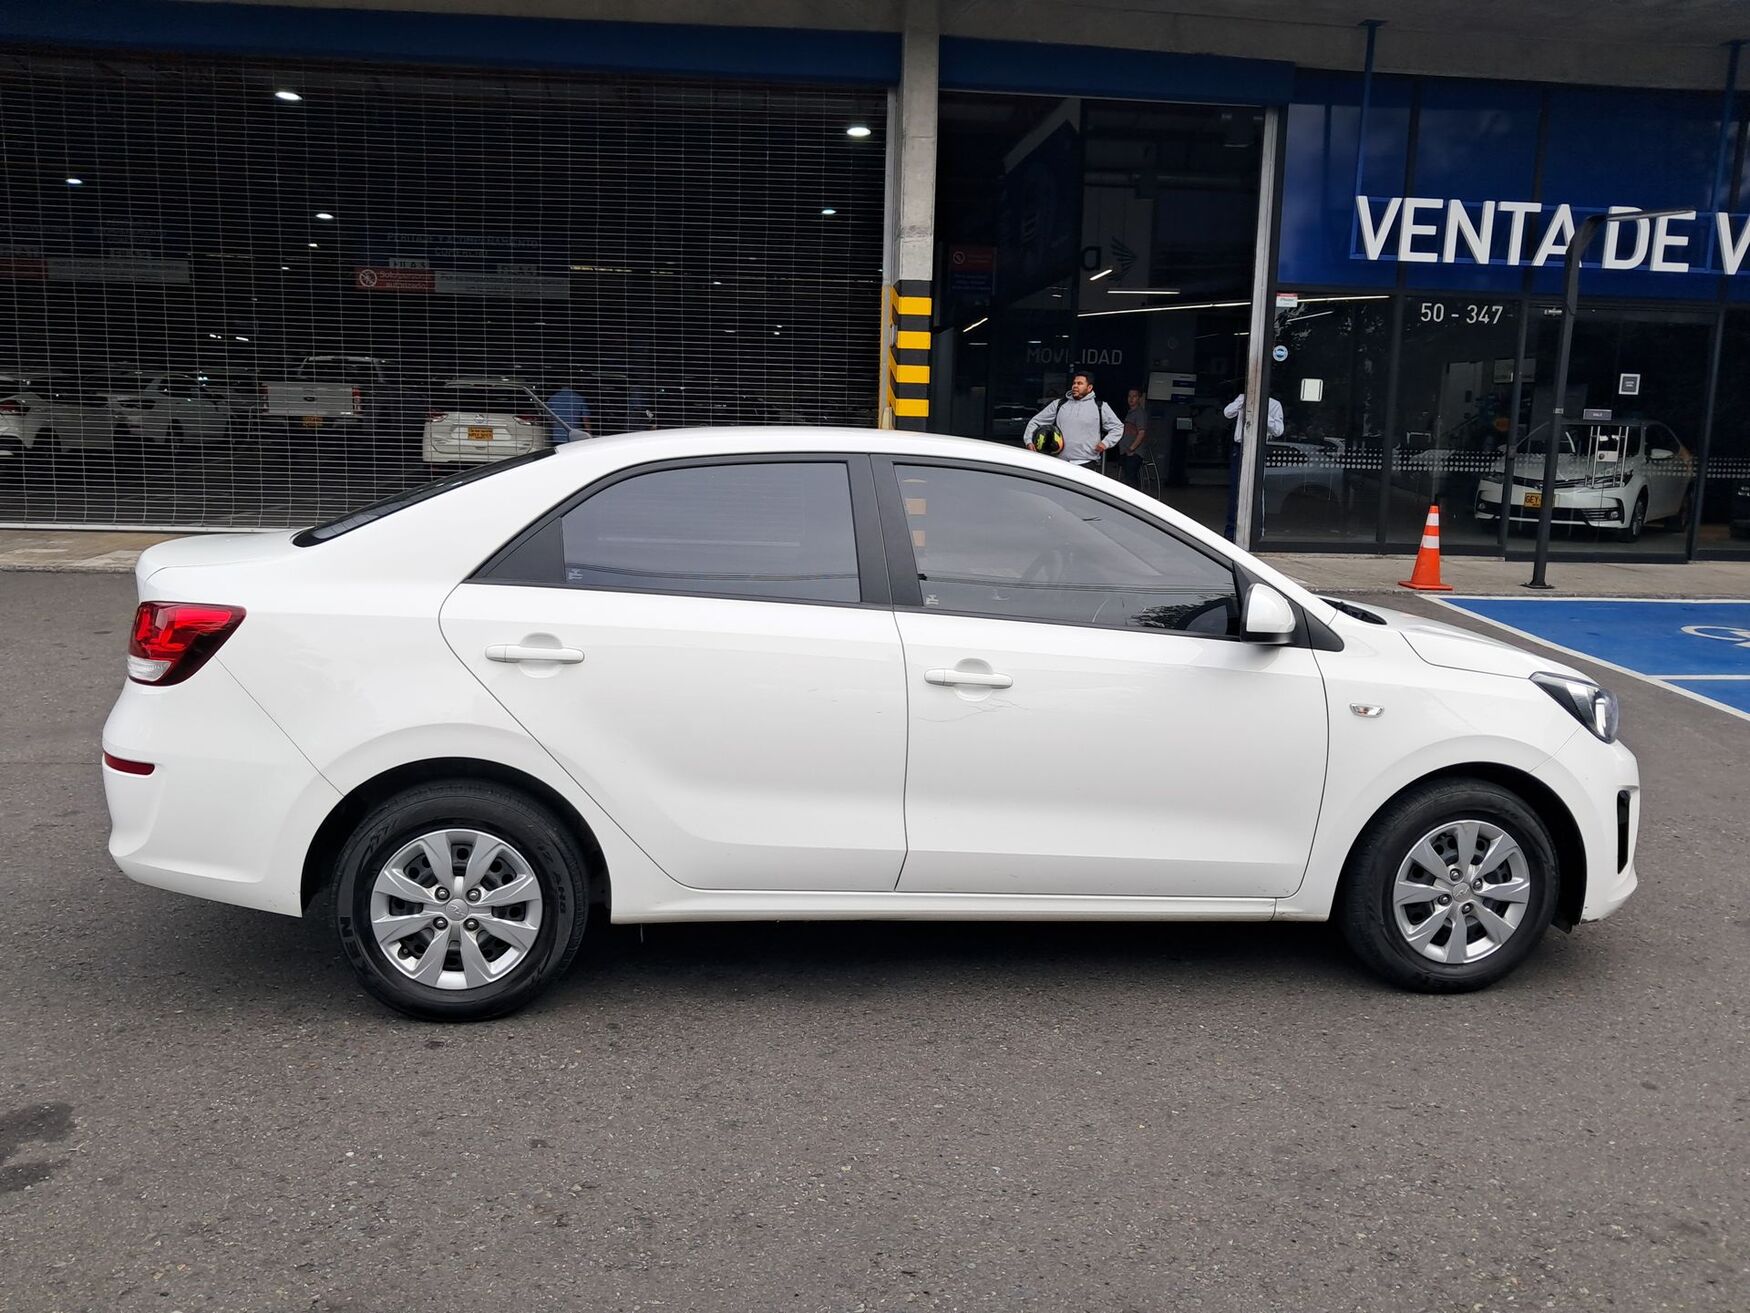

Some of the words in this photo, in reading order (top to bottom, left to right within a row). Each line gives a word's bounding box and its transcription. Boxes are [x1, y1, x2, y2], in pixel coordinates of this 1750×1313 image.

[1356, 195, 1583, 267] VENTA
[1601, 206, 1697, 273] DE
[1420, 302, 1445, 323] 50
[1465, 304, 1504, 325] 347
[1025, 347, 1123, 366] MOVIIDAD
